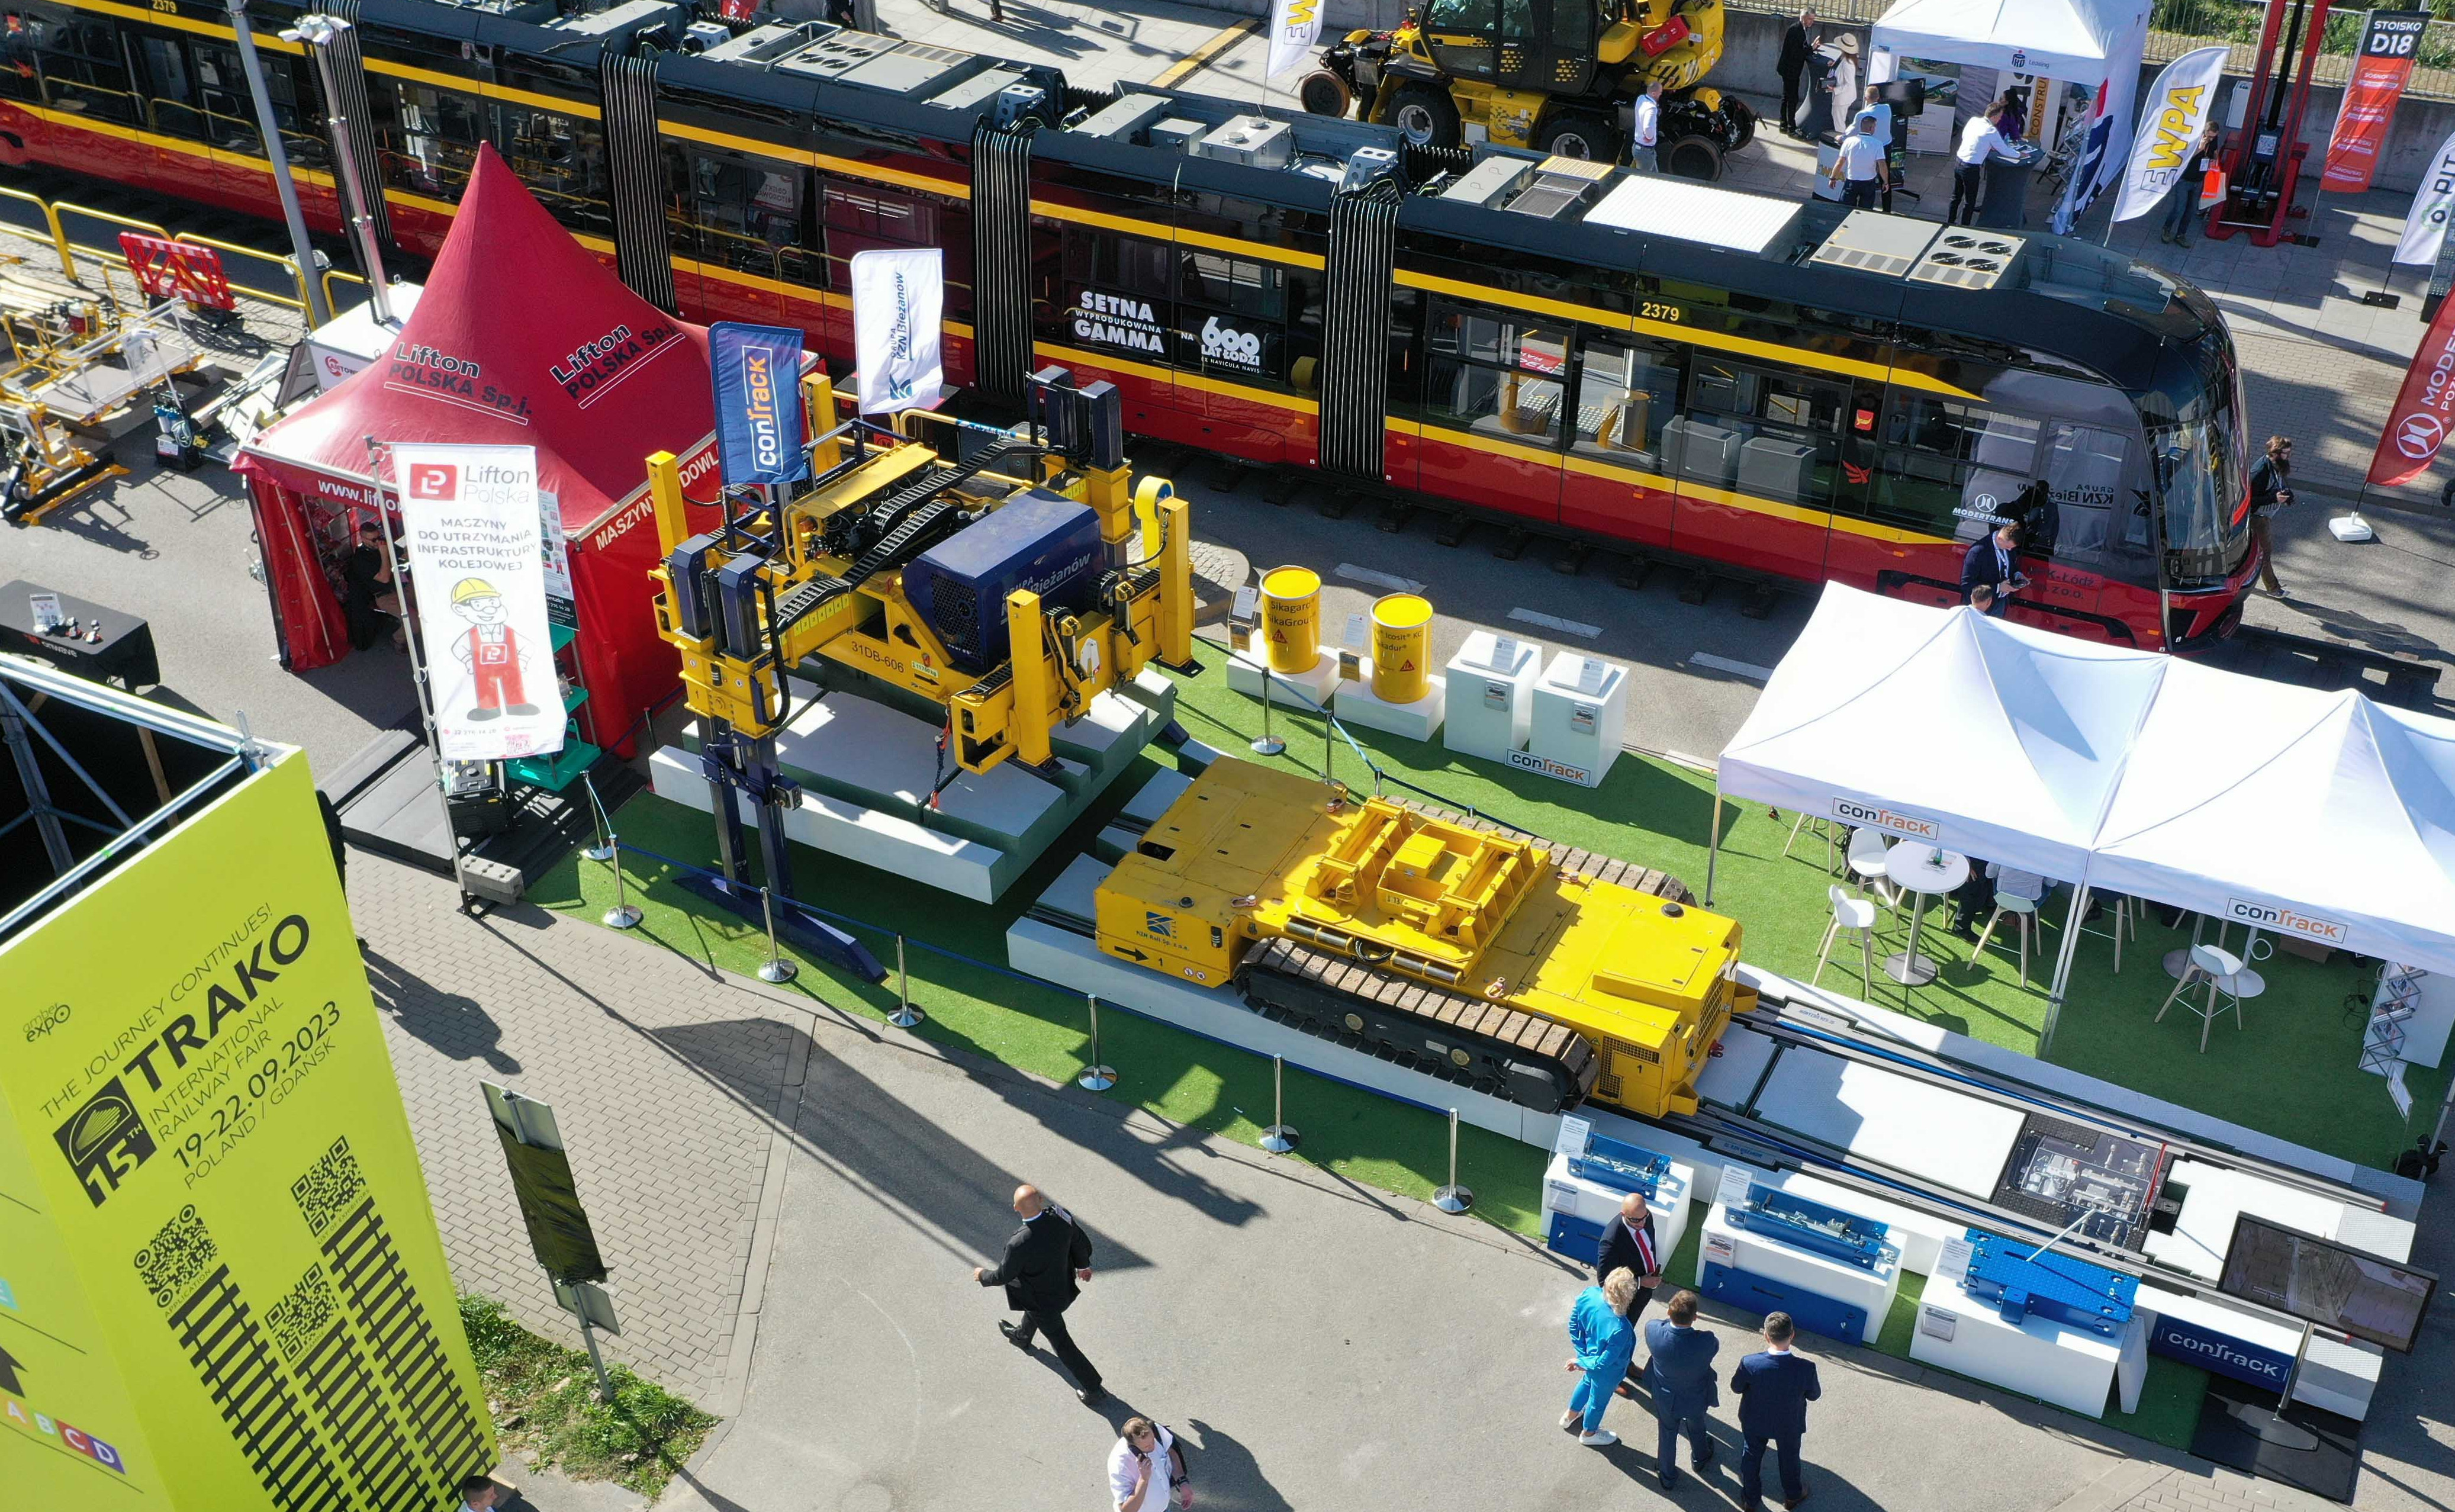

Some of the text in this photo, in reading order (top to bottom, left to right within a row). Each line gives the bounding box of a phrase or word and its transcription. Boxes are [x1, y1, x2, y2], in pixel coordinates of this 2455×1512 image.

[153, 0, 176, 13] 2379
[2373, 20, 2422, 32] STOISKO
[2370, 33, 2414, 54] D18
[2139, 85, 2205, 193] EWPA
[895, 272, 908, 360] KZN Bieżanów
[1075, 310, 1161, 334] WYPRODUKOWANA
[1081, 291, 1154, 323] SETNA
[1641, 302, 1680, 321] 2379
[1074, 320, 1164, 353] GAMMA
[1181, 332, 1194, 342] NA
[1201, 316, 1260, 356] 600
[394, 342, 480, 379] Lifton
[549, 324, 632, 385] Lifton
[1201, 344, 1260, 366] LAT ŁODZI
[1210, 357, 1240, 369] NAVICULA
[1242, 365, 1260, 374] NAVIS
[565, 342, 643, 400] POLSKA
[388, 362, 473, 398] POLSKA
[481, 385, 533, 416] Sp.j.
[465, 465, 530, 484] Lifton
[464, 484, 530, 504] Polska
[440, 518, 507, 530] MASZYNY
[1952, 507, 2015, 526] MODERTRANS
[417, 542, 536, 557] INFRASTRUKTURY
[418, 529, 532, 544] DO UTRZYMANIA
[438, 559, 523, 571] KOLEJOWEJ
[851, 641, 905, 673] 31DB-606
[1511, 754, 1585, 781] conTrack
[1839, 803, 1931, 835] conTrack
[2234, 904, 2338, 938] conTrack
[38, 902, 274, 1119] THE JOURNEY CONTINUES!
[123, 914, 310, 1093] TRAKO
[26, 1004, 71, 1043] expo
[148, 996, 284, 1125] INTERNATIONAL
[157, 1029, 272, 1143] RAILWAY FAIR
[184, 1115, 256, 1191] POLAND
[270, 1036, 336, 1105] GDAŃSK
[2168, 1333, 2279, 1377] conTrack
[8, 1401, 115, 1463] A B C D
